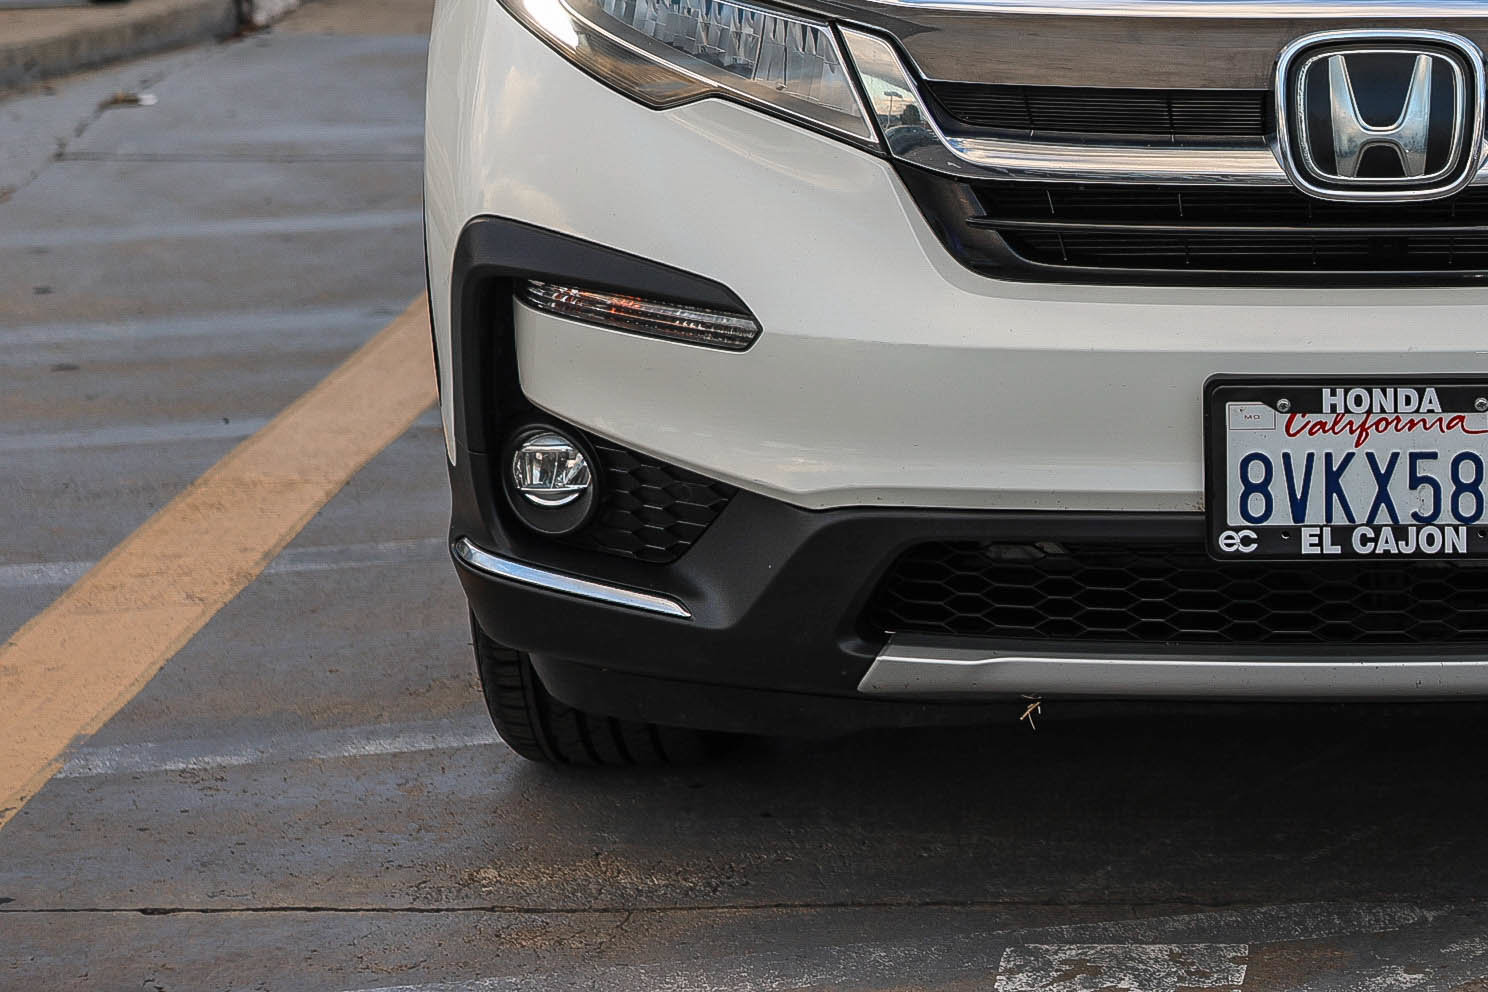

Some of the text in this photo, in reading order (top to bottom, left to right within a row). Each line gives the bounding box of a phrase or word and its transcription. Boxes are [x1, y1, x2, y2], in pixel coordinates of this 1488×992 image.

[1321, 388, 1442, 414] HONDA
[1285, 413, 1488, 448] California
[1301, 526, 1468, 554] EL CAJON
